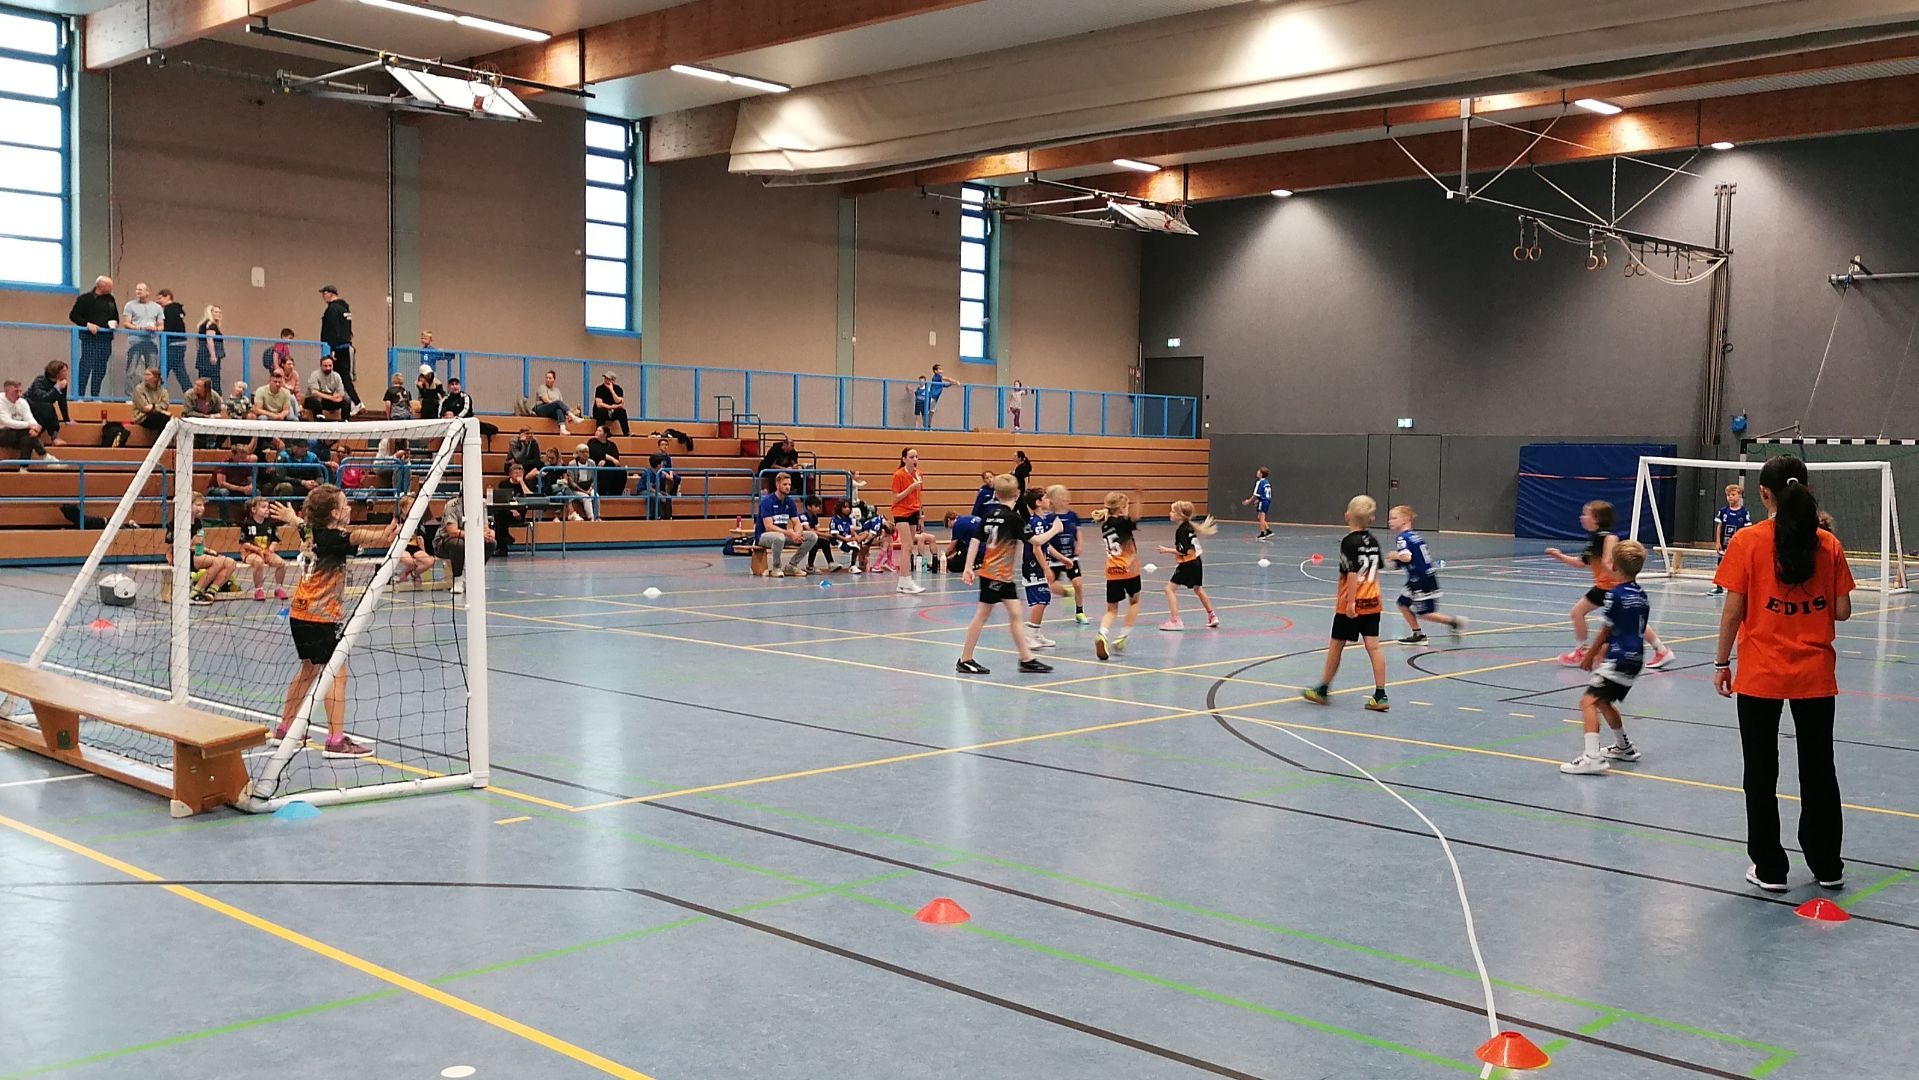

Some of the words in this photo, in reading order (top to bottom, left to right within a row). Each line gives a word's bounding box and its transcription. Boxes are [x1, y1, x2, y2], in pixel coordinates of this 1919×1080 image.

[1722, 513, 1728, 522] 2
[1357, 554, 1379, 584] 27
[1765, 595, 1828, 616] EDIS
